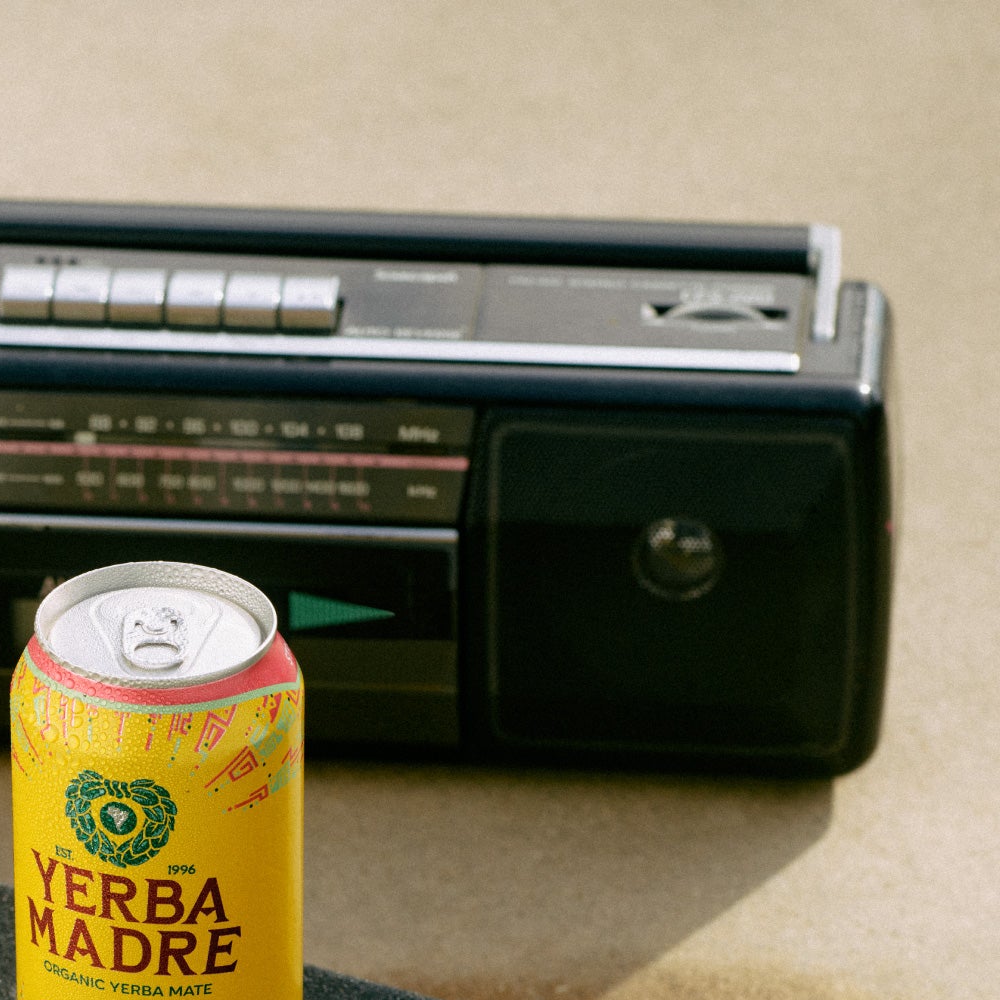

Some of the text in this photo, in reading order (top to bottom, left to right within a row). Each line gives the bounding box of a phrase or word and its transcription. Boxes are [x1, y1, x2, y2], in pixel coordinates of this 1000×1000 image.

[30, 847, 229, 925] YERBA
[167, 864, 196, 876] 1996
[26, 895, 241, 975] MADRE
[43, 959, 213, 997] ORGANIC YERBA MATE
